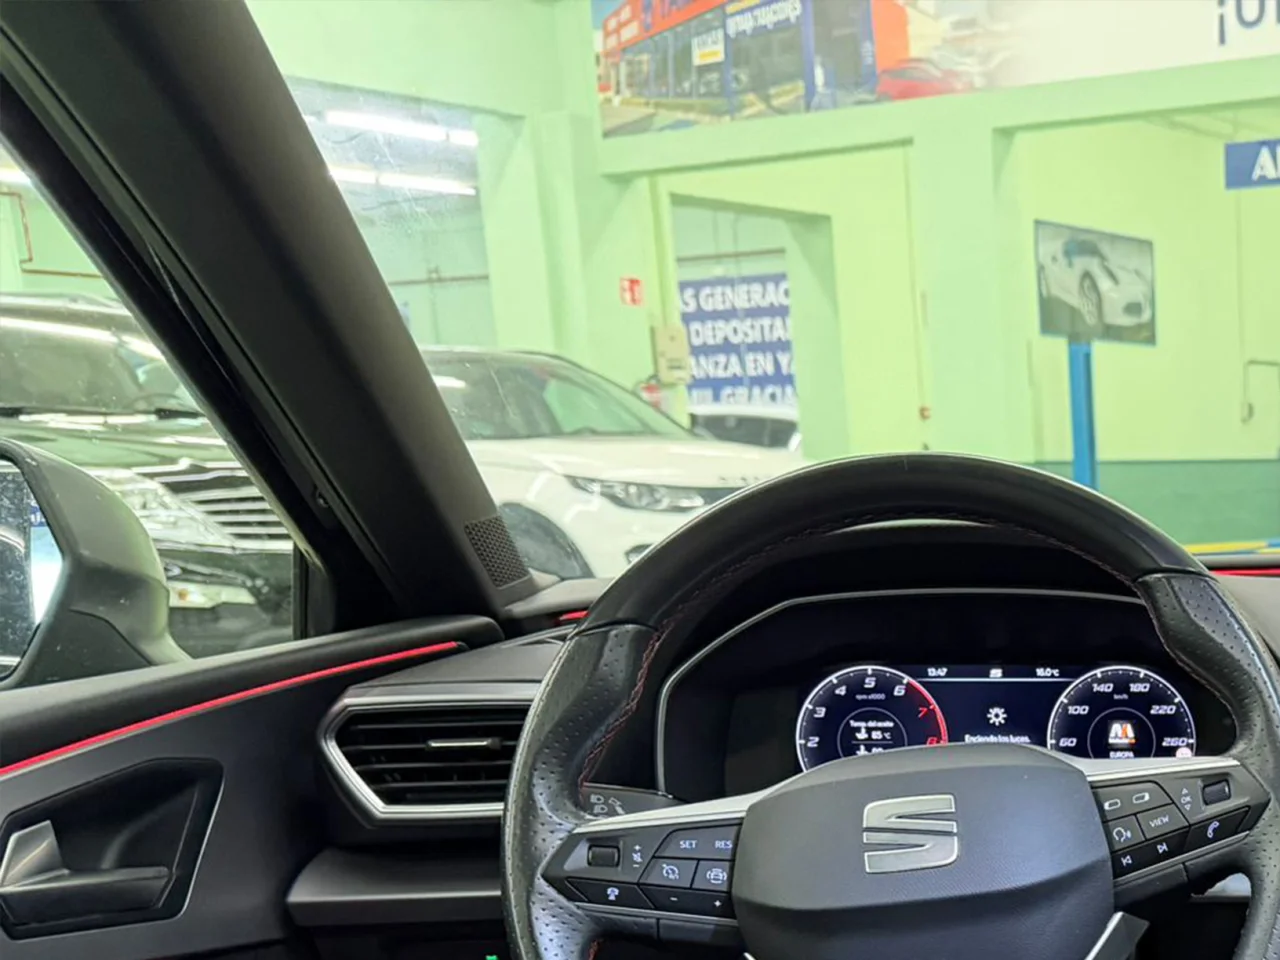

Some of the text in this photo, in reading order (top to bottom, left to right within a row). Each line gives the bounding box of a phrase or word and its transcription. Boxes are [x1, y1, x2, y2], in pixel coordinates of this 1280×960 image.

[745, 350, 776, 376] EN
[927, 668, 948, 677] 13:47
[864, 677, 876, 688] 5
[1093, 683, 1114, 692] 140
[1129, 683, 1151, 692] 180
[834, 685, 847, 696] 4
[893, 685, 907, 696] 6
[813, 706, 827, 718] 3
[918, 706, 928, 718] 7
[1067, 705, 1090, 715] 100
[1150, 705, 1176, 715] 220
[806, 736, 819, 747] 2
[1059, 738, 1077, 747] 60
[1162, 738, 1188, 747] 260
[1180, 796, 1192, 804] OK
[1149, 815, 1170, 828] VIEW
[679, 839, 697, 849] SET
[714, 839, 733, 849] RES
